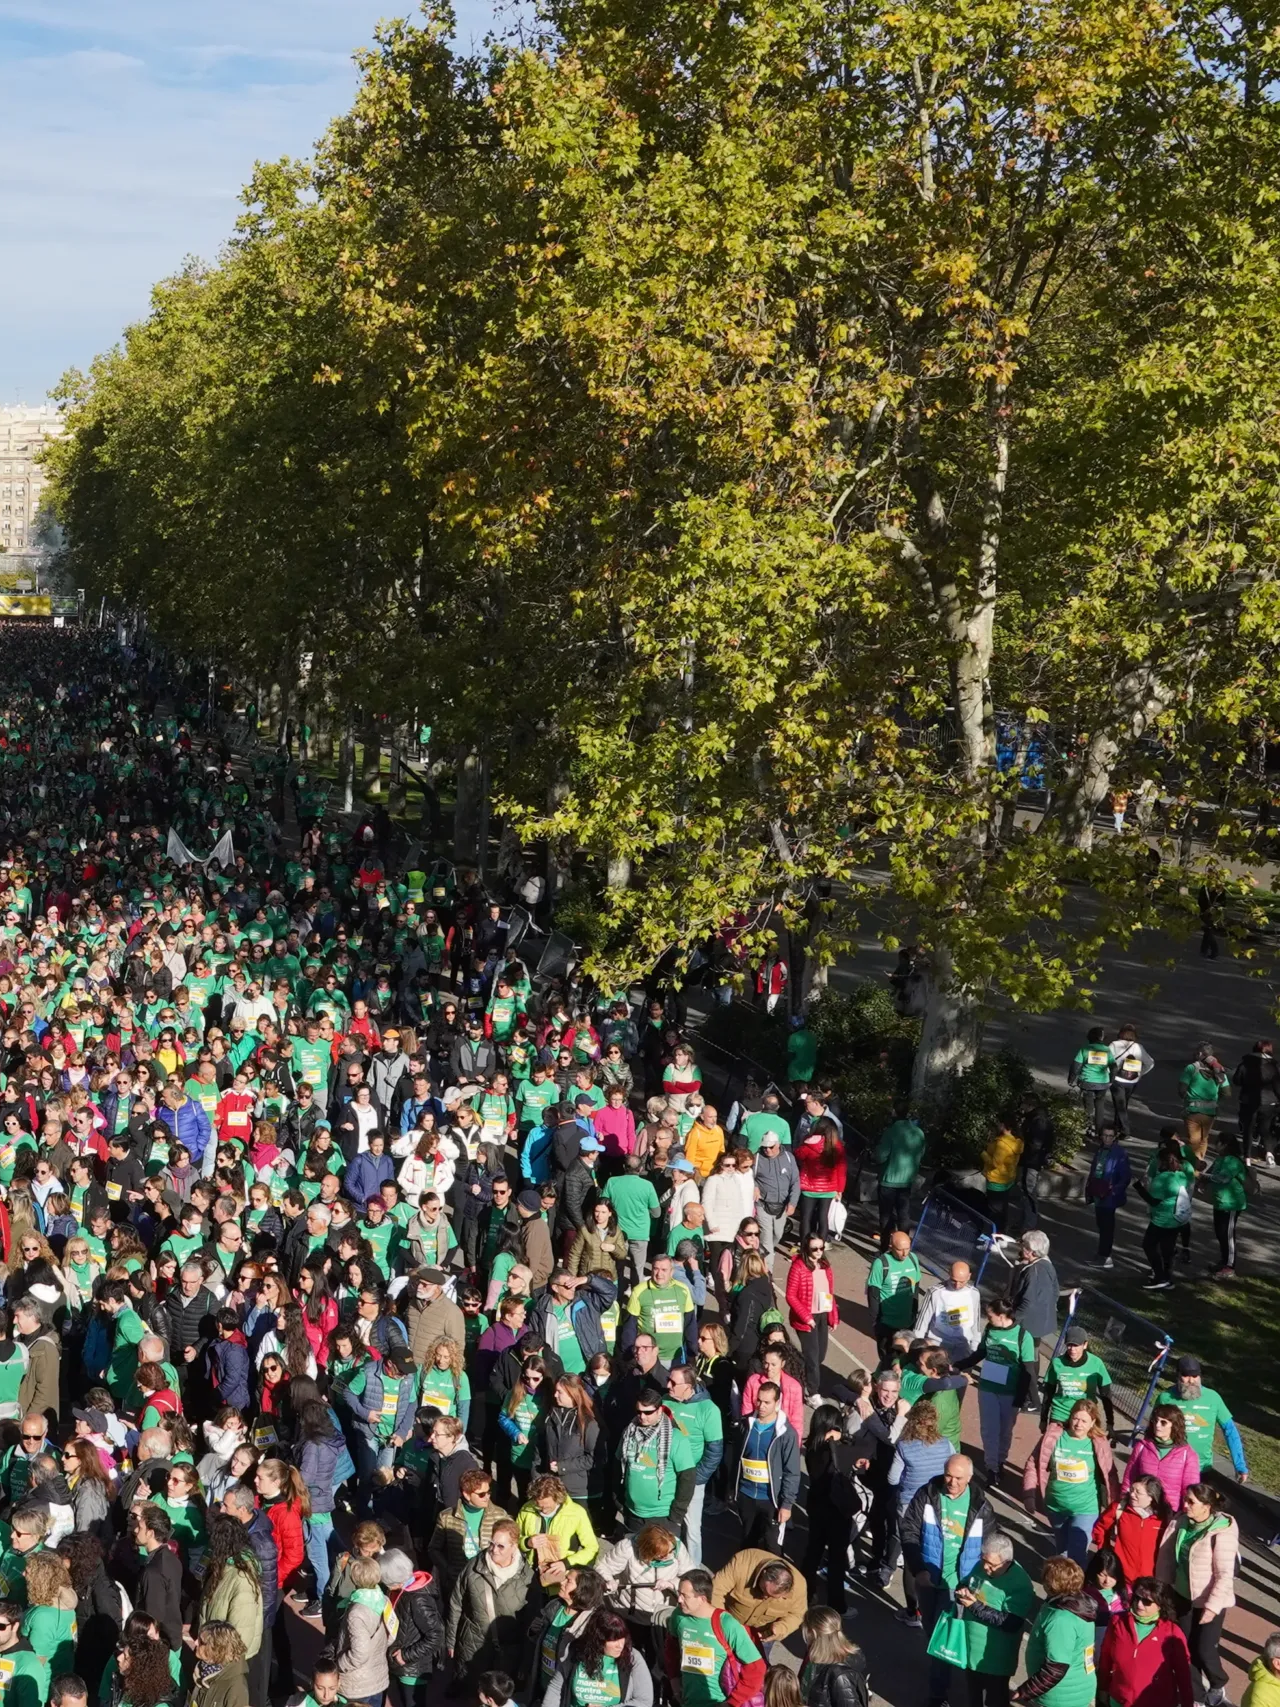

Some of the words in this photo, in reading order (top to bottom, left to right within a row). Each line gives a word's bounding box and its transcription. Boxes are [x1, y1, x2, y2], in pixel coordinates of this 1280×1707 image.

[687, 1656, 701, 1666] 5135
[576, 1679, 607, 1688] marcha
[575, 1686, 602, 1694] contra
[583, 1694, 613, 1702] cáncer
